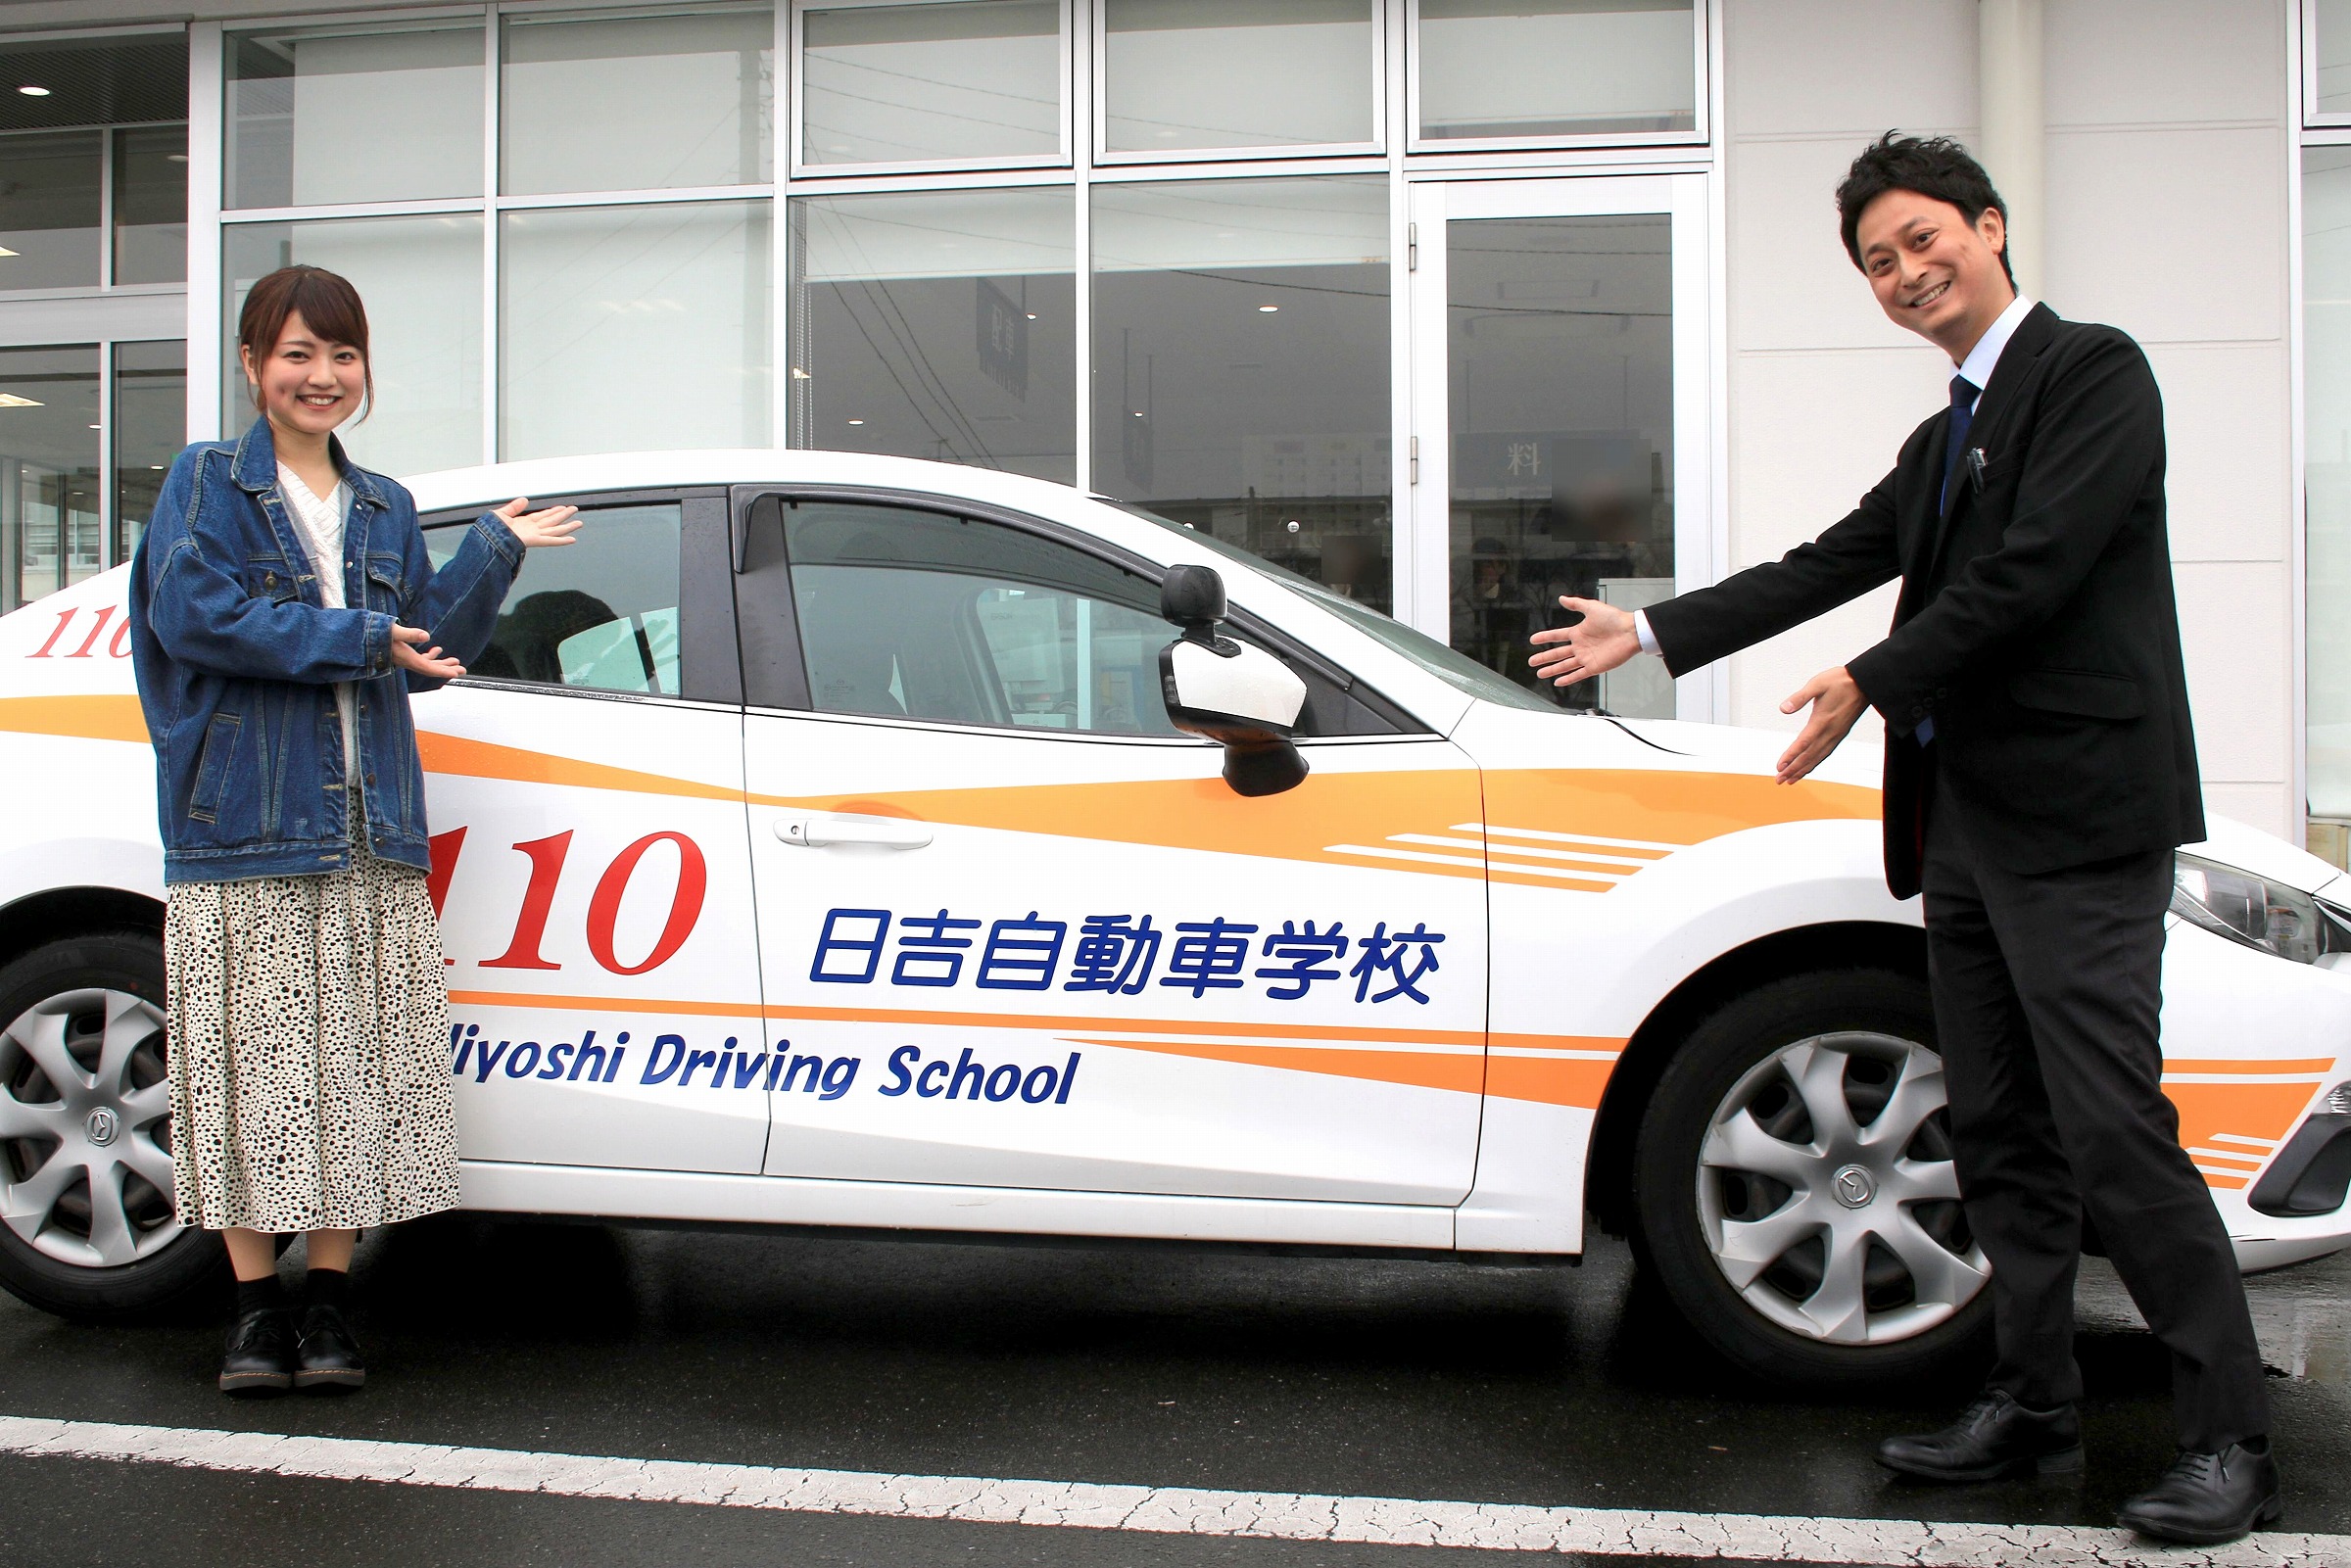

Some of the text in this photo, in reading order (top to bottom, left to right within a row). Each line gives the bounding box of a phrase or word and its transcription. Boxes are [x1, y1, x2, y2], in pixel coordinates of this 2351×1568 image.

[809, 908, 1446, 1005] 日吉自動車学校
[639, 1034, 860, 1102] Driving
[877, 1044, 1081, 1105] School
